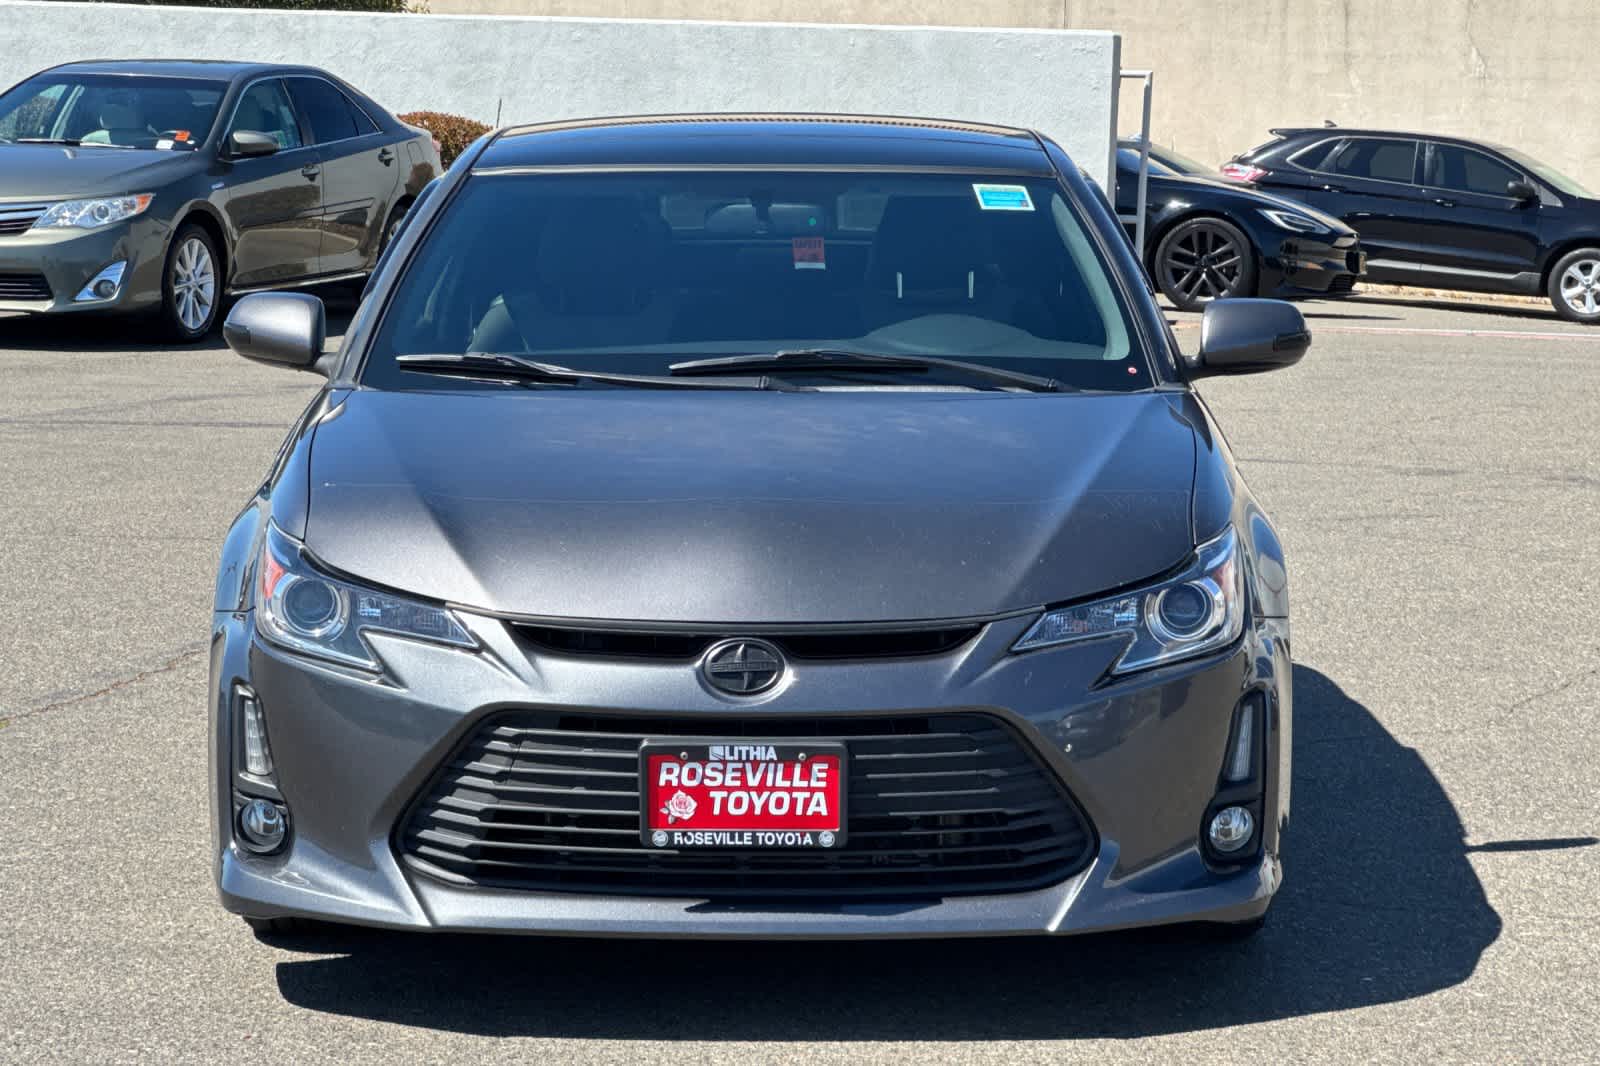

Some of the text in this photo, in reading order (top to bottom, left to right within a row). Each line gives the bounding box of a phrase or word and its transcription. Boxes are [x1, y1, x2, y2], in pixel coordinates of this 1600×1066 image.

[724, 746, 778, 761] LITHIA
[658, 762, 829, 787] ROSEVILLE
[709, 791, 829, 816] TOYOTA
[674, 832, 814, 845] ROSEVILLE TOYOTA
